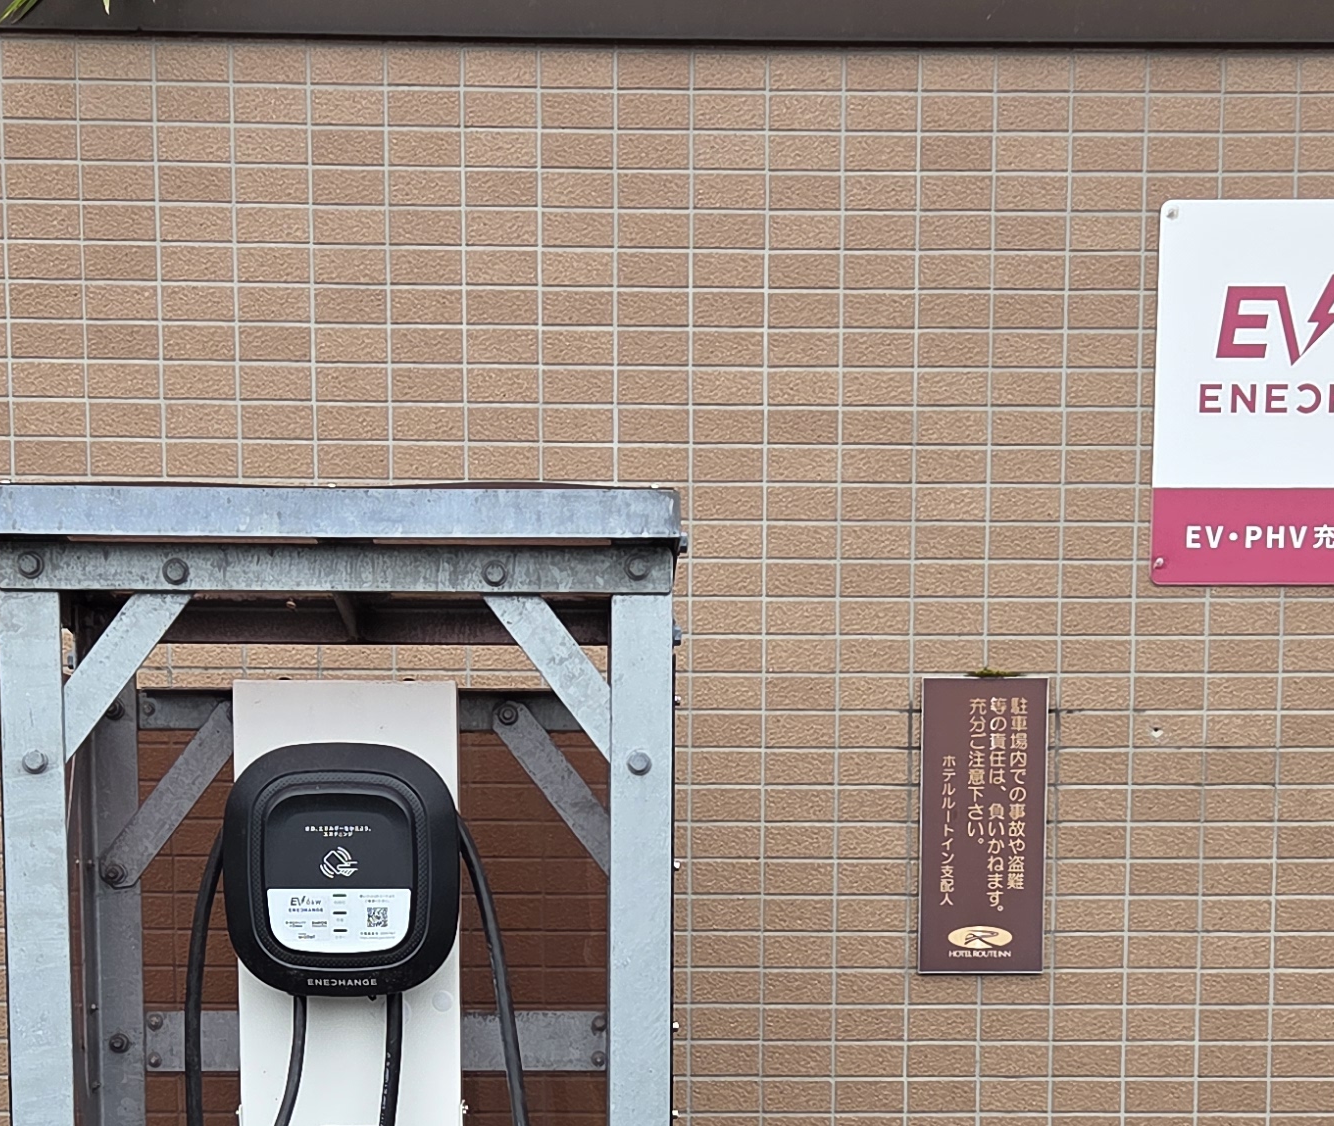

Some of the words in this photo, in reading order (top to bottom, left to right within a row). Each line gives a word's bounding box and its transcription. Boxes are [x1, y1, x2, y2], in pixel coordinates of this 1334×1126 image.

[939, 755, 956, 906] ホテルルートイン支配人
[967, 698, 987, 845] 充分ご注意下さい。
[986, 696, 1008, 912] 等の責任は、負いかねます。
[1007, 697, 1029, 890] 駐車場内での事故や盗難
[307, 978, 378, 987] ENECHANGE
[948, 950, 973, 958] HOTEL
[972, 950, 997, 958] ROUTE
[998, 950, 1012, 958] INN
